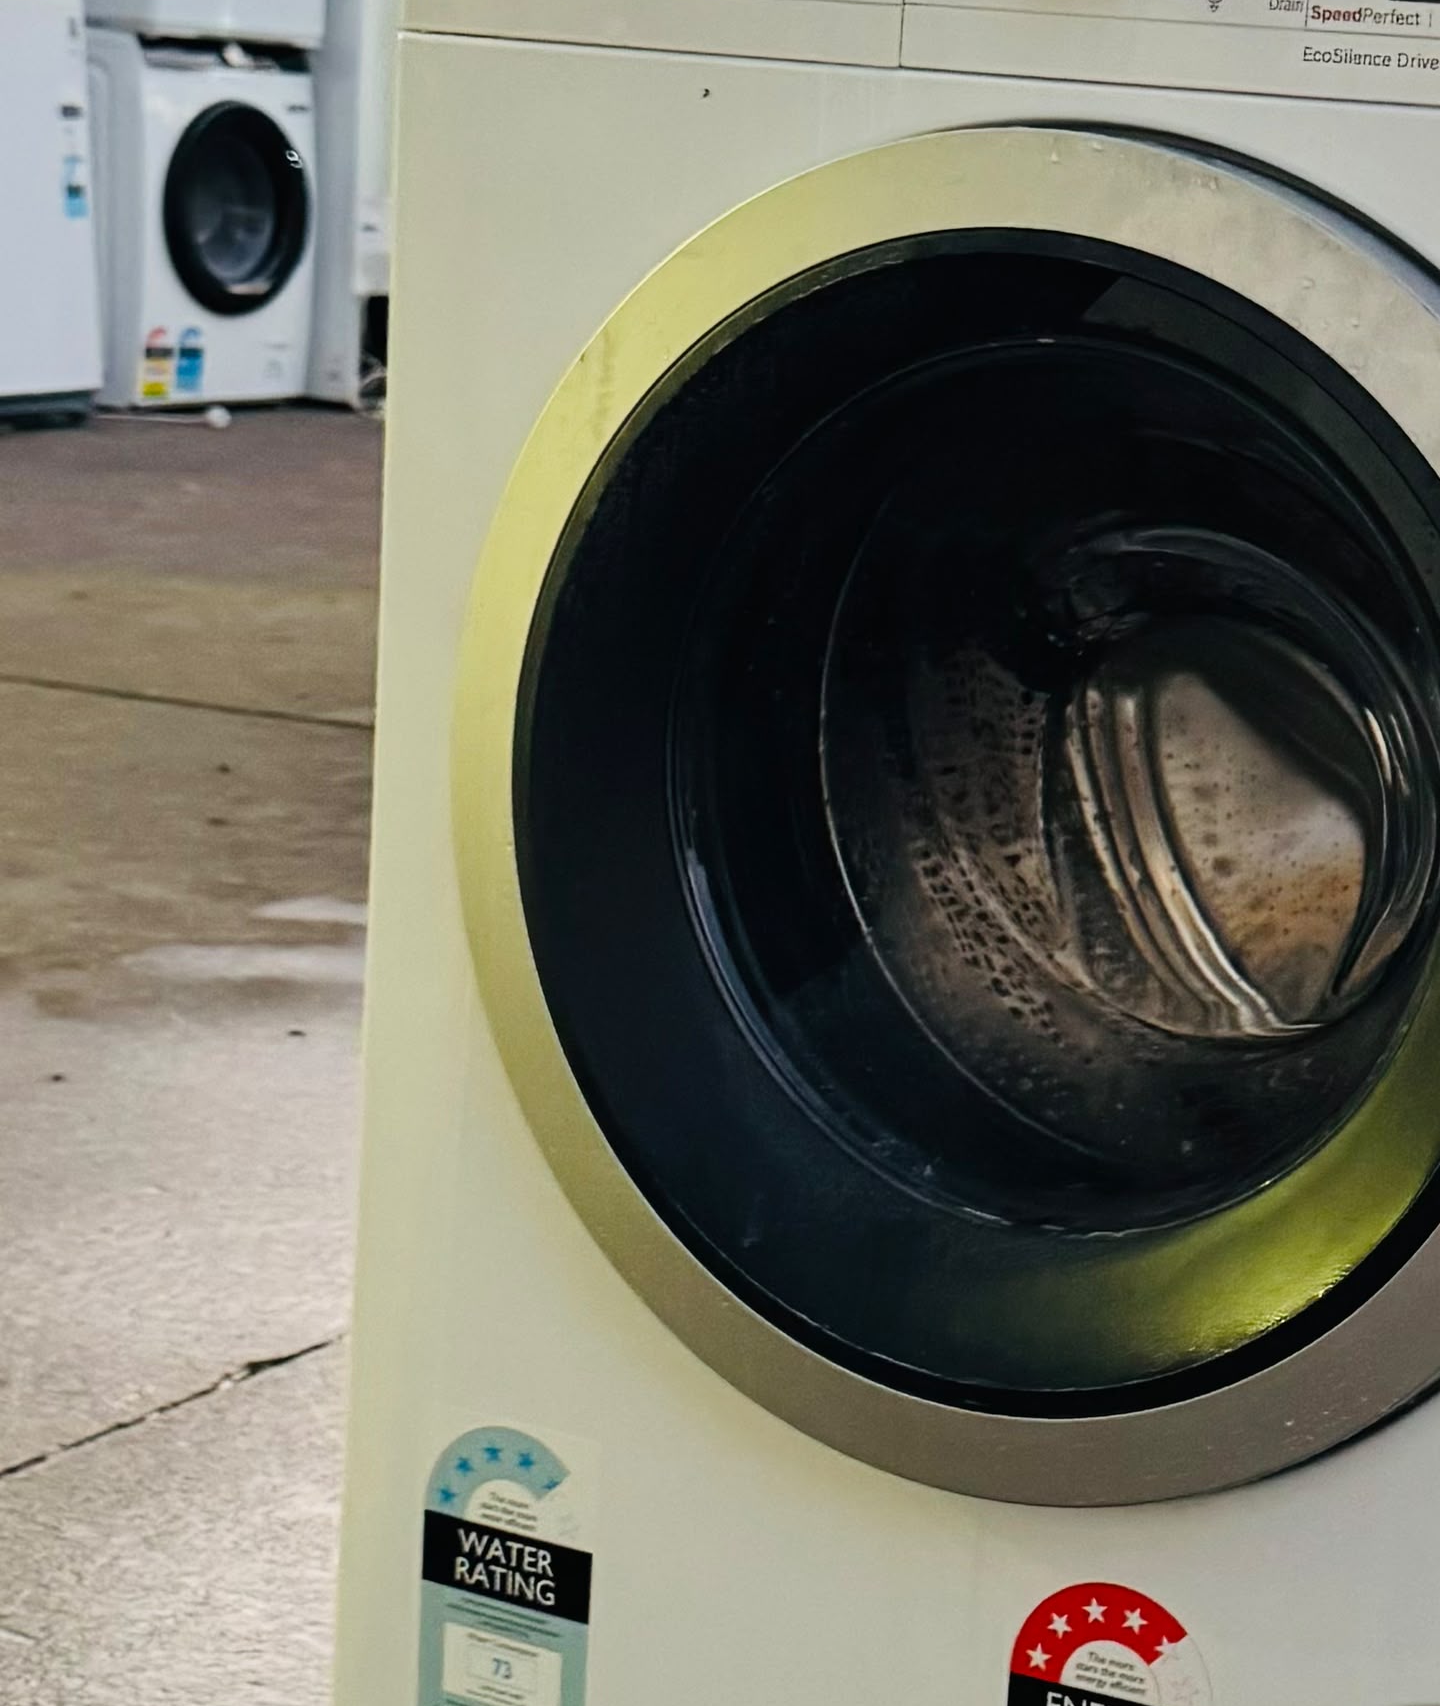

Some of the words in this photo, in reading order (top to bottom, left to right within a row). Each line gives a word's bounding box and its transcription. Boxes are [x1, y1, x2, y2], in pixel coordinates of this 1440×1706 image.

[1311, 5, 1420, 26] SpeedPerfect
[1303, 46, 1392, 68] EcoSilence
[1397, 52, 1440, 70] Drive
[457, 1527, 554, 1578] WATER
[454, 1555, 556, 1606] RATING
